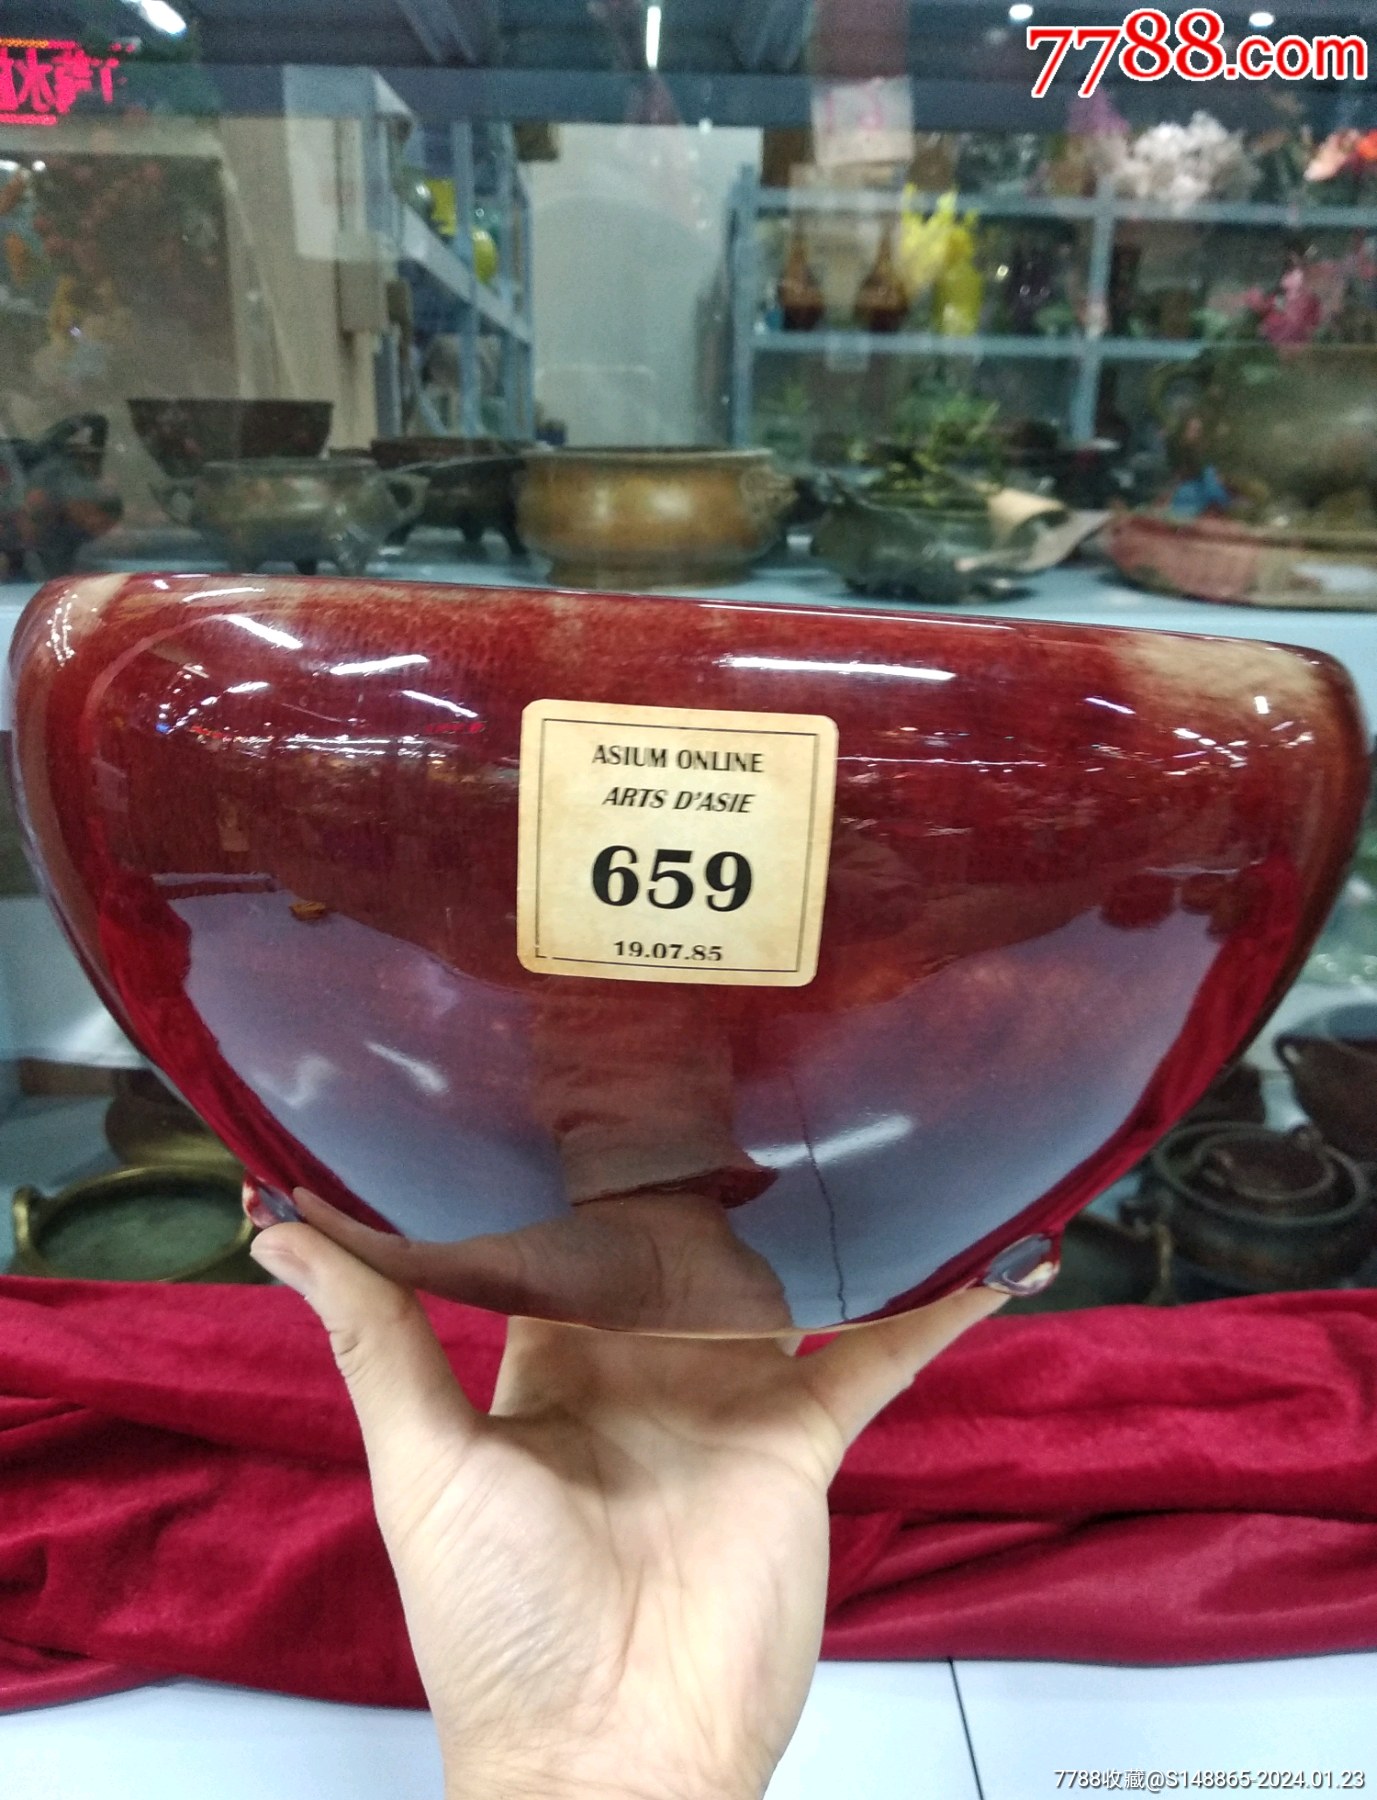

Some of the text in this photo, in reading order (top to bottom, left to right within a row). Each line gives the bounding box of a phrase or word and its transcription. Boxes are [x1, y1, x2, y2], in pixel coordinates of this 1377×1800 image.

[592, 744, 764, 773] ASIUM ONLINE
[602, 786, 756, 813] ARTS D'ASIE
[591, 845, 753, 912] 659
[614, 941, 723, 961] 19.07.85
